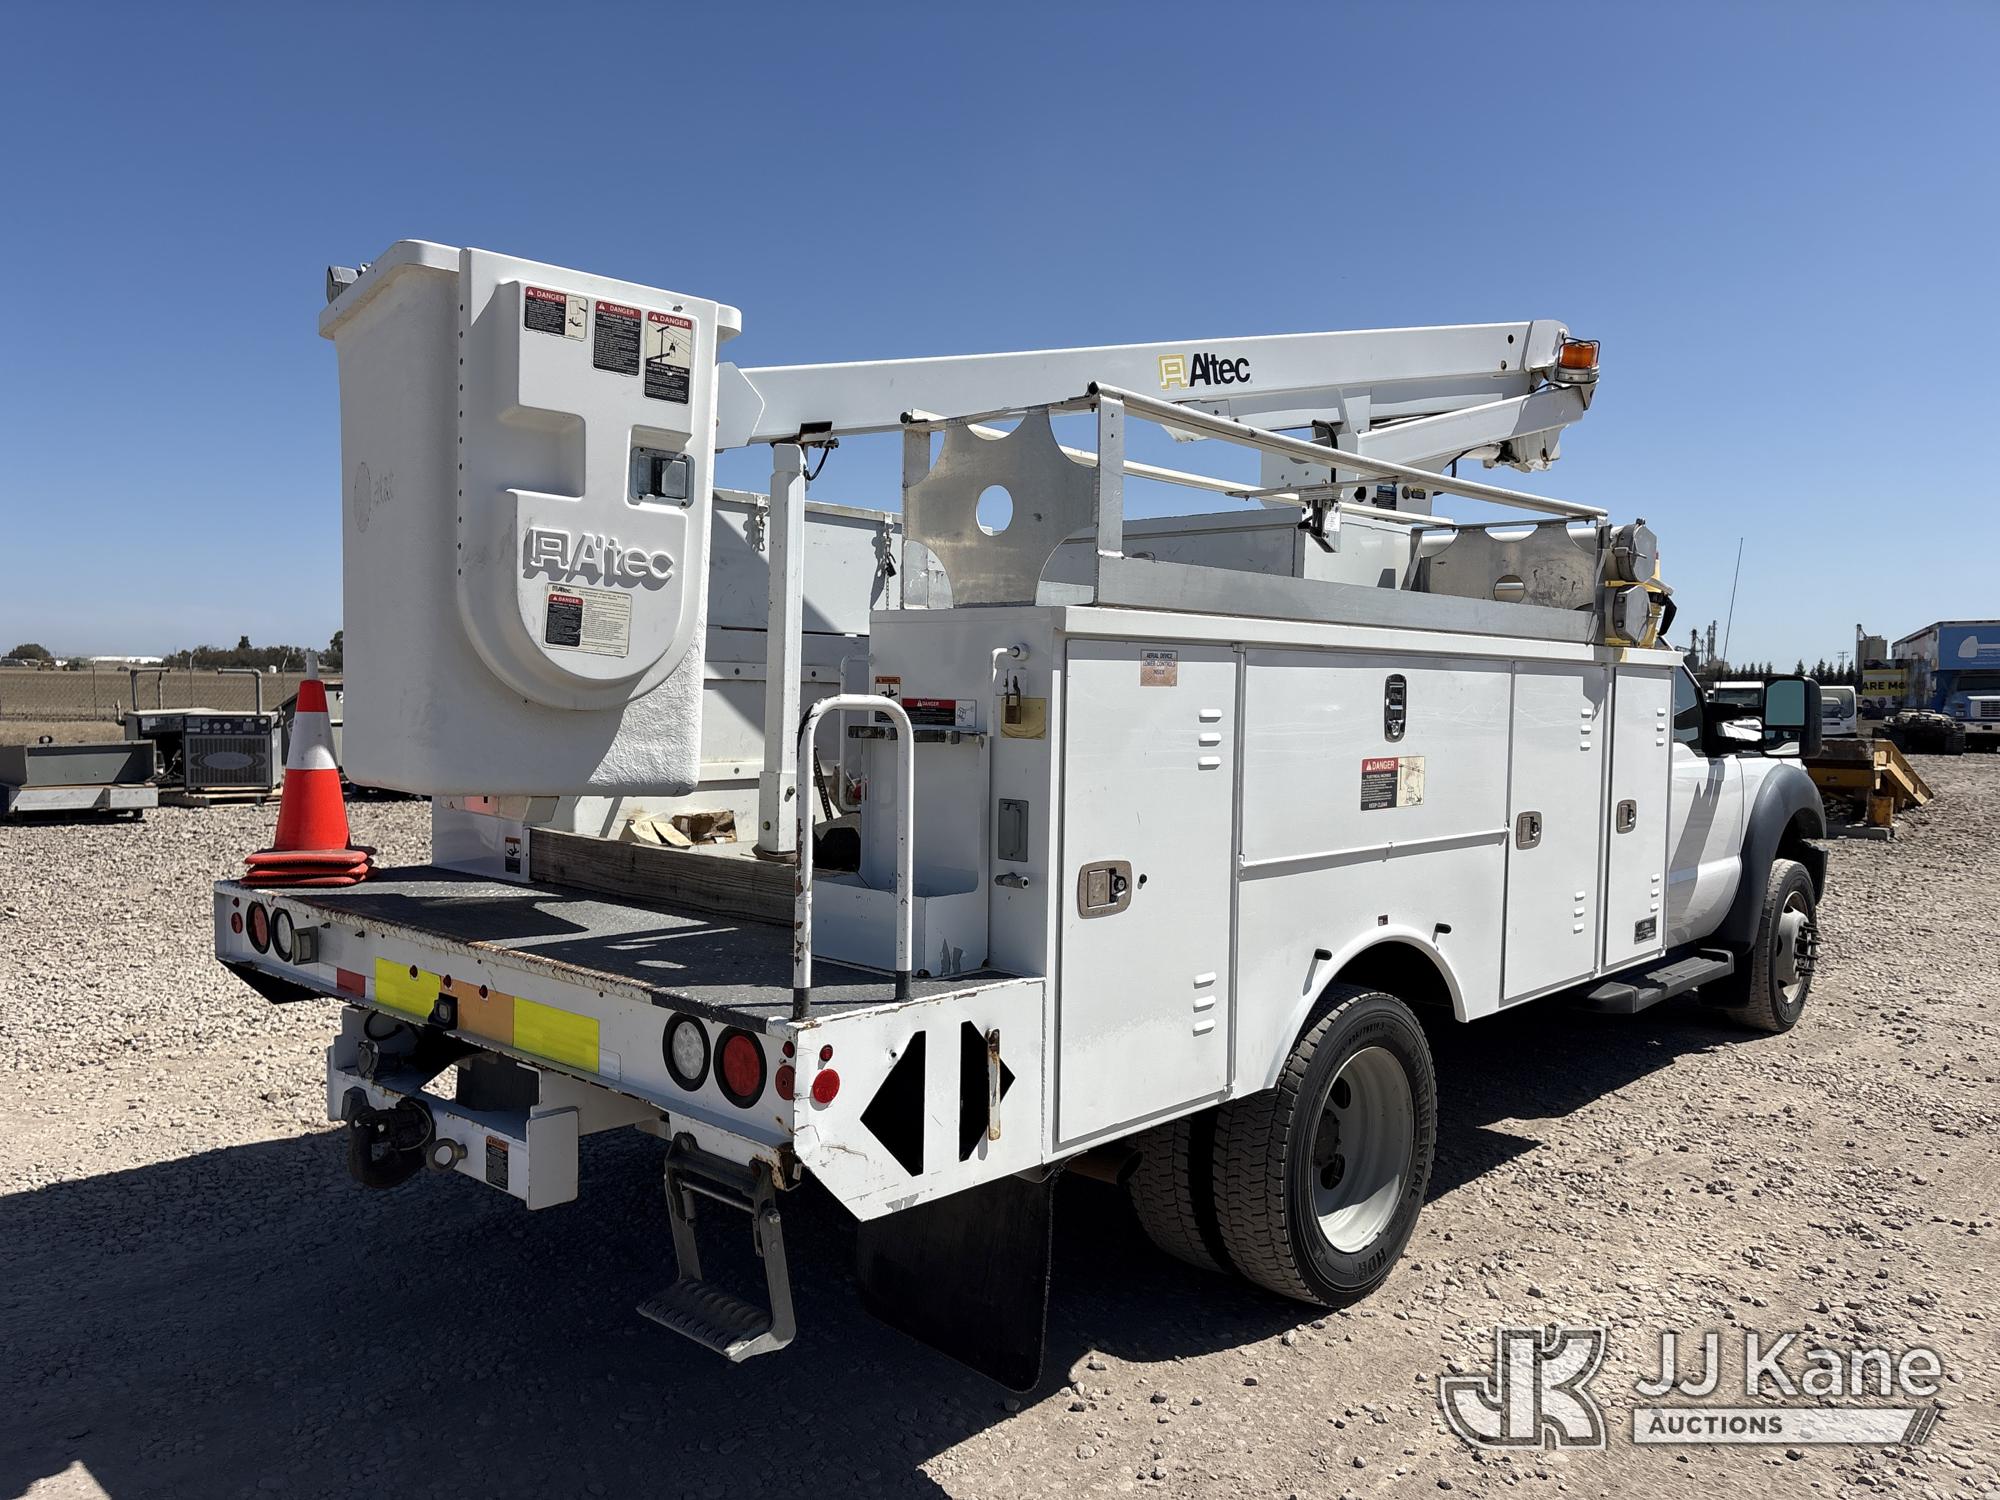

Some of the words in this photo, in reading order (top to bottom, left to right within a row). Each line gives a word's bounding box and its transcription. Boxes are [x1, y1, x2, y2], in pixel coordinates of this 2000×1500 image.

[536, 290, 565, 302] DANGER
[609, 304, 635, 315] DANGER
[659, 315, 689, 327] DANGER
[1189, 353, 1250, 387] Altec
[567, 533, 674, 590] Altec
[1372, 760, 1395, 770] DANGER
